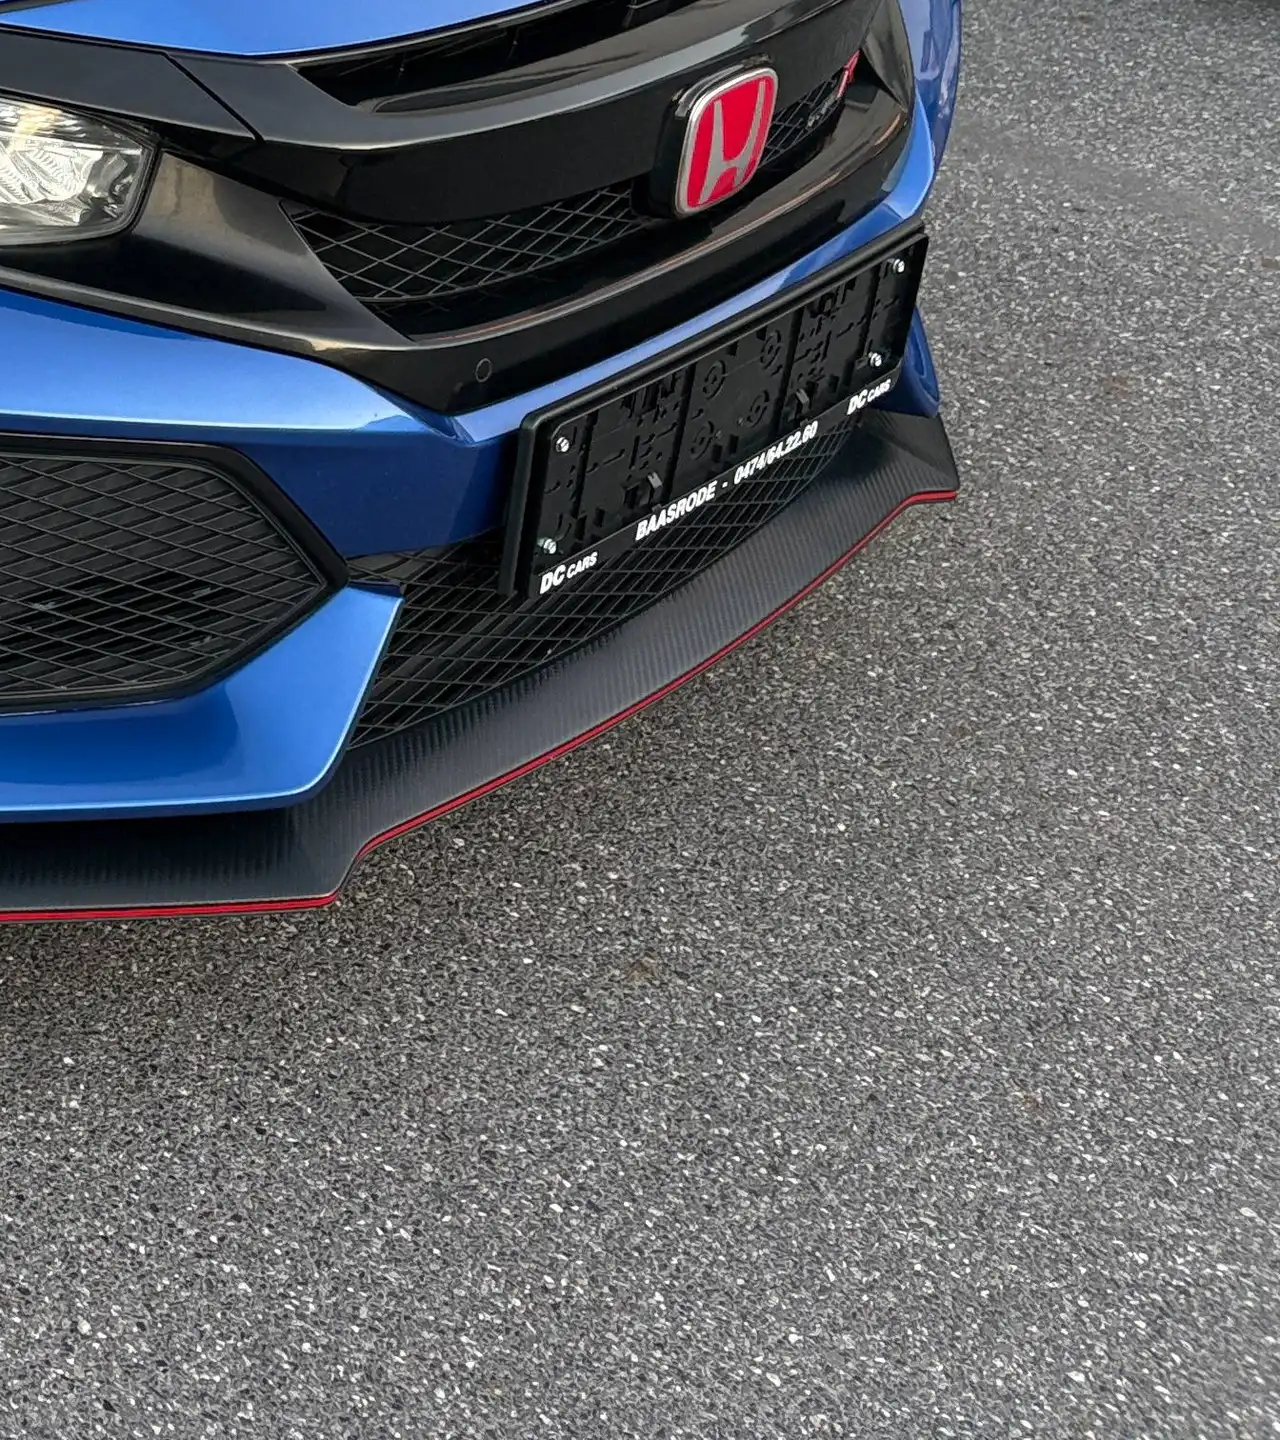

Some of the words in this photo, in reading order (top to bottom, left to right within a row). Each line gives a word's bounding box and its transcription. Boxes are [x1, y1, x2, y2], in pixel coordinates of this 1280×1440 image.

[846, 388, 868, 416] DC
[635, 480, 718, 541] BAASRODE
[540, 564, 567, 595] DC
[566, 551, 599, 580] CARS
